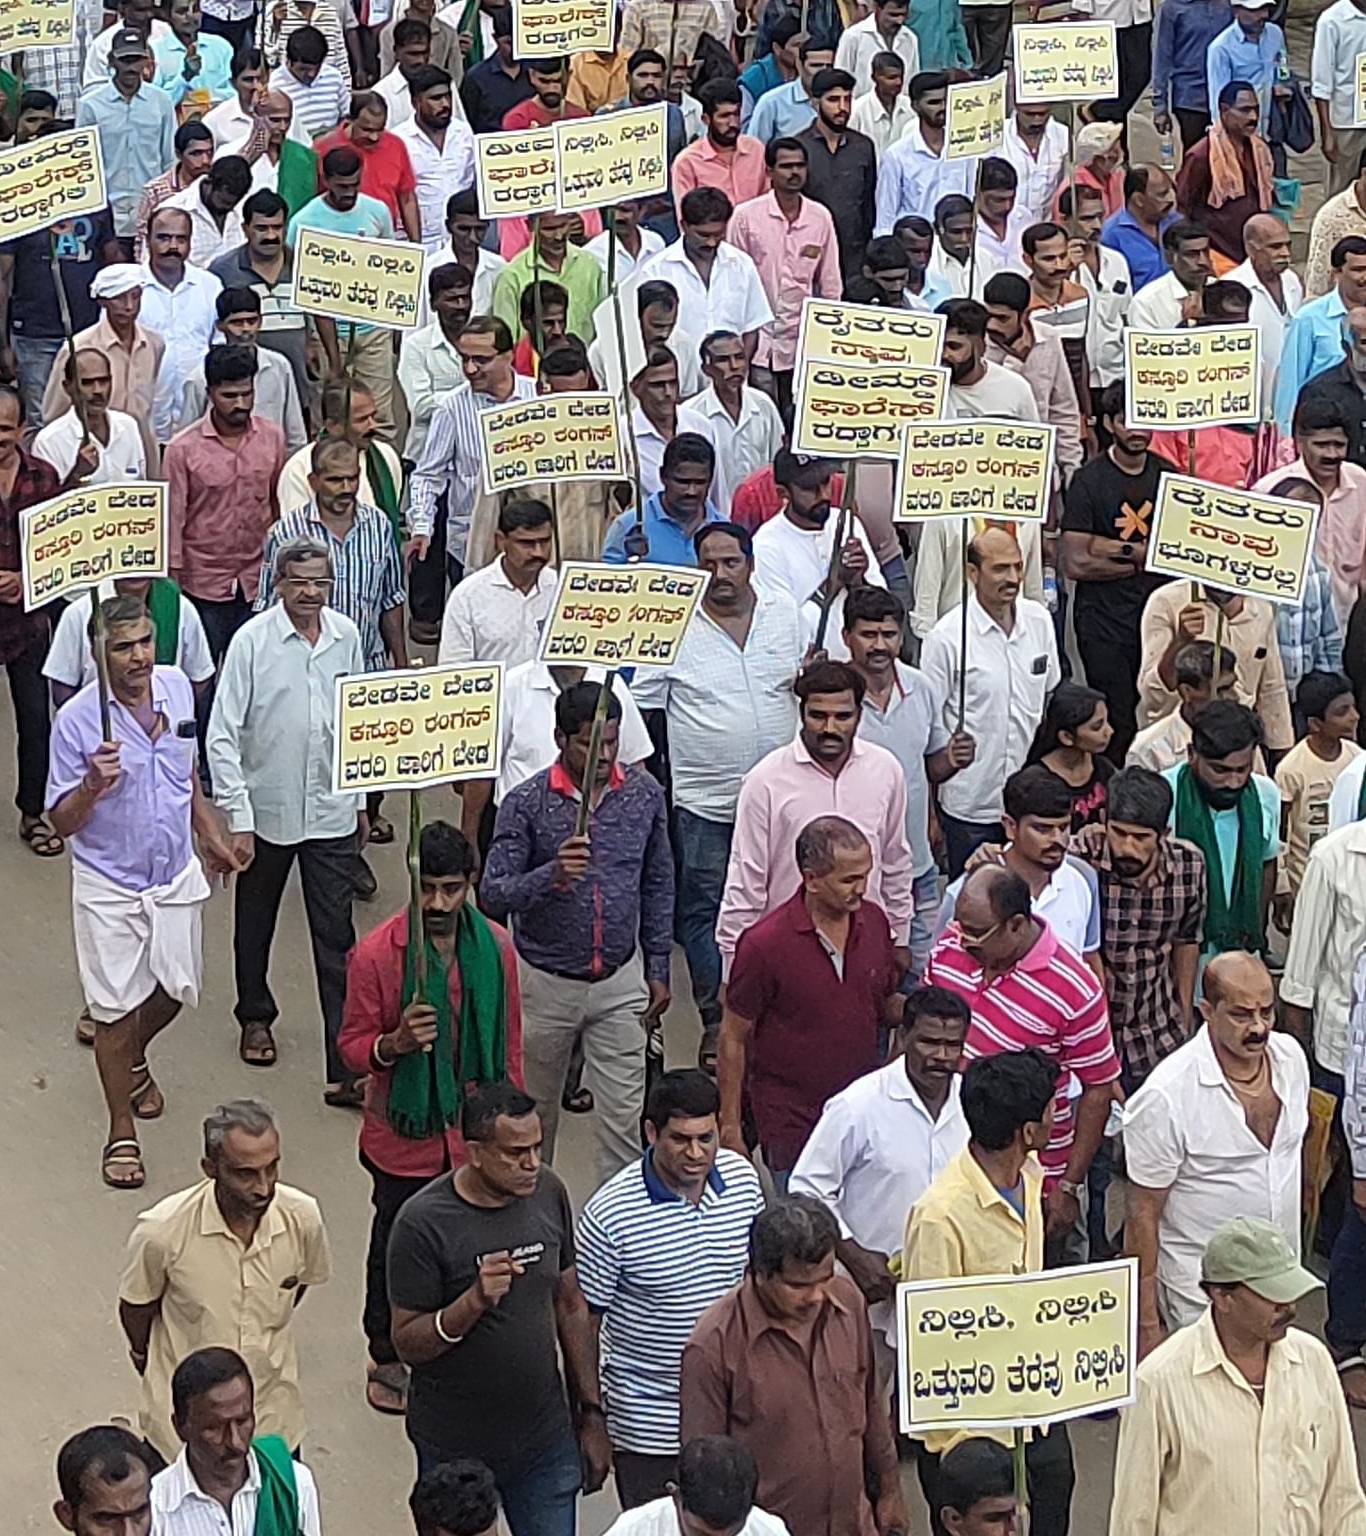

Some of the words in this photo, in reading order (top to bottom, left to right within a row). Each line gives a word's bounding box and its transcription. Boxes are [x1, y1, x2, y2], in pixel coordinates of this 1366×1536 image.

[911, 427, 984, 449] ಬೇಡವೇ
[995, 429, 1045, 451] ಬೇಡ
[911, 458, 968, 483] ಕಸ್ತೂರಿ
[975, 456, 1040, 478] ರಂಗನ್
[1170, 487, 1304, 528] ರೈತರು
[1188, 519, 1279, 558] ನಾವು
[1157, 541, 1296, 592] ಭೂಗಳ್ಳರಲ್ಲ
[347, 680, 431, 708] ಬೇಡವೇ
[442, 672, 494, 696] ಬೇಡ
[349, 717, 414, 746] ಕಸ್ತೂರಿ
[424, 704, 491, 733] ರಂಗನ್
[344, 752, 387, 781] ವರದಿ
[396, 742, 444, 775] ಜಾರಿಗೆ
[452, 738, 490, 767] ಬೇಡ
[918, 1304, 1014, 1340] ನಿಲ್ಲಿಸಿ,
[1034, 1289, 1117, 1326] ನಿಲ್ಲಿಸಿ
[912, 1359, 995, 1409] ಒತ್ತುವರಿ
[1006, 1351, 1063, 1397] ತೆರವು
[1074, 1343, 1125, 1392] ನಿಲ್ಲಿಸಿ
